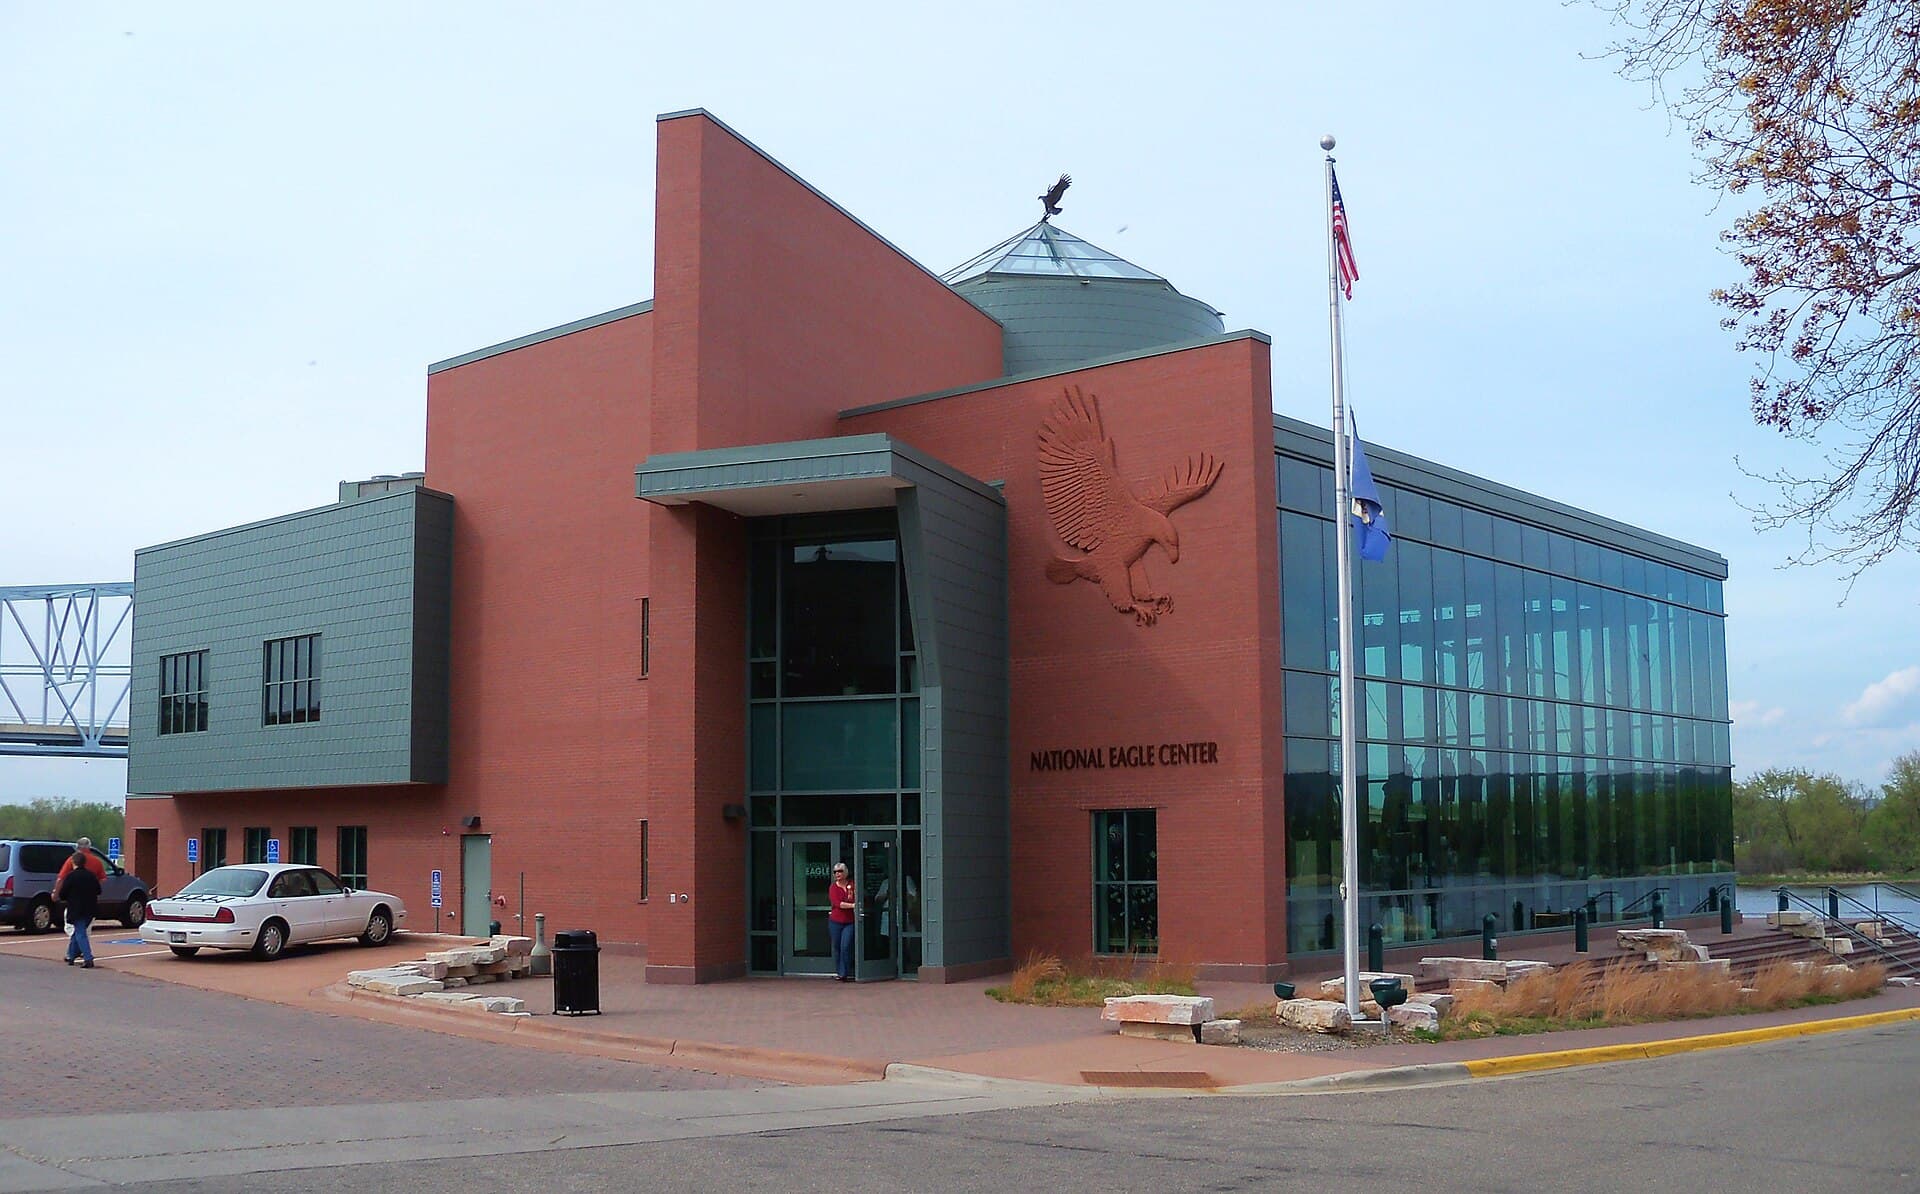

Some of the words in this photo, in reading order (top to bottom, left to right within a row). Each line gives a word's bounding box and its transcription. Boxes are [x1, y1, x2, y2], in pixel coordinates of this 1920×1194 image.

[1030, 748, 1105, 772] NATIONAL
[1109, 745, 1155, 768] EAGLE
[1158, 742, 1218, 766] CENTER
[805, 867, 830, 875] EAGLE
